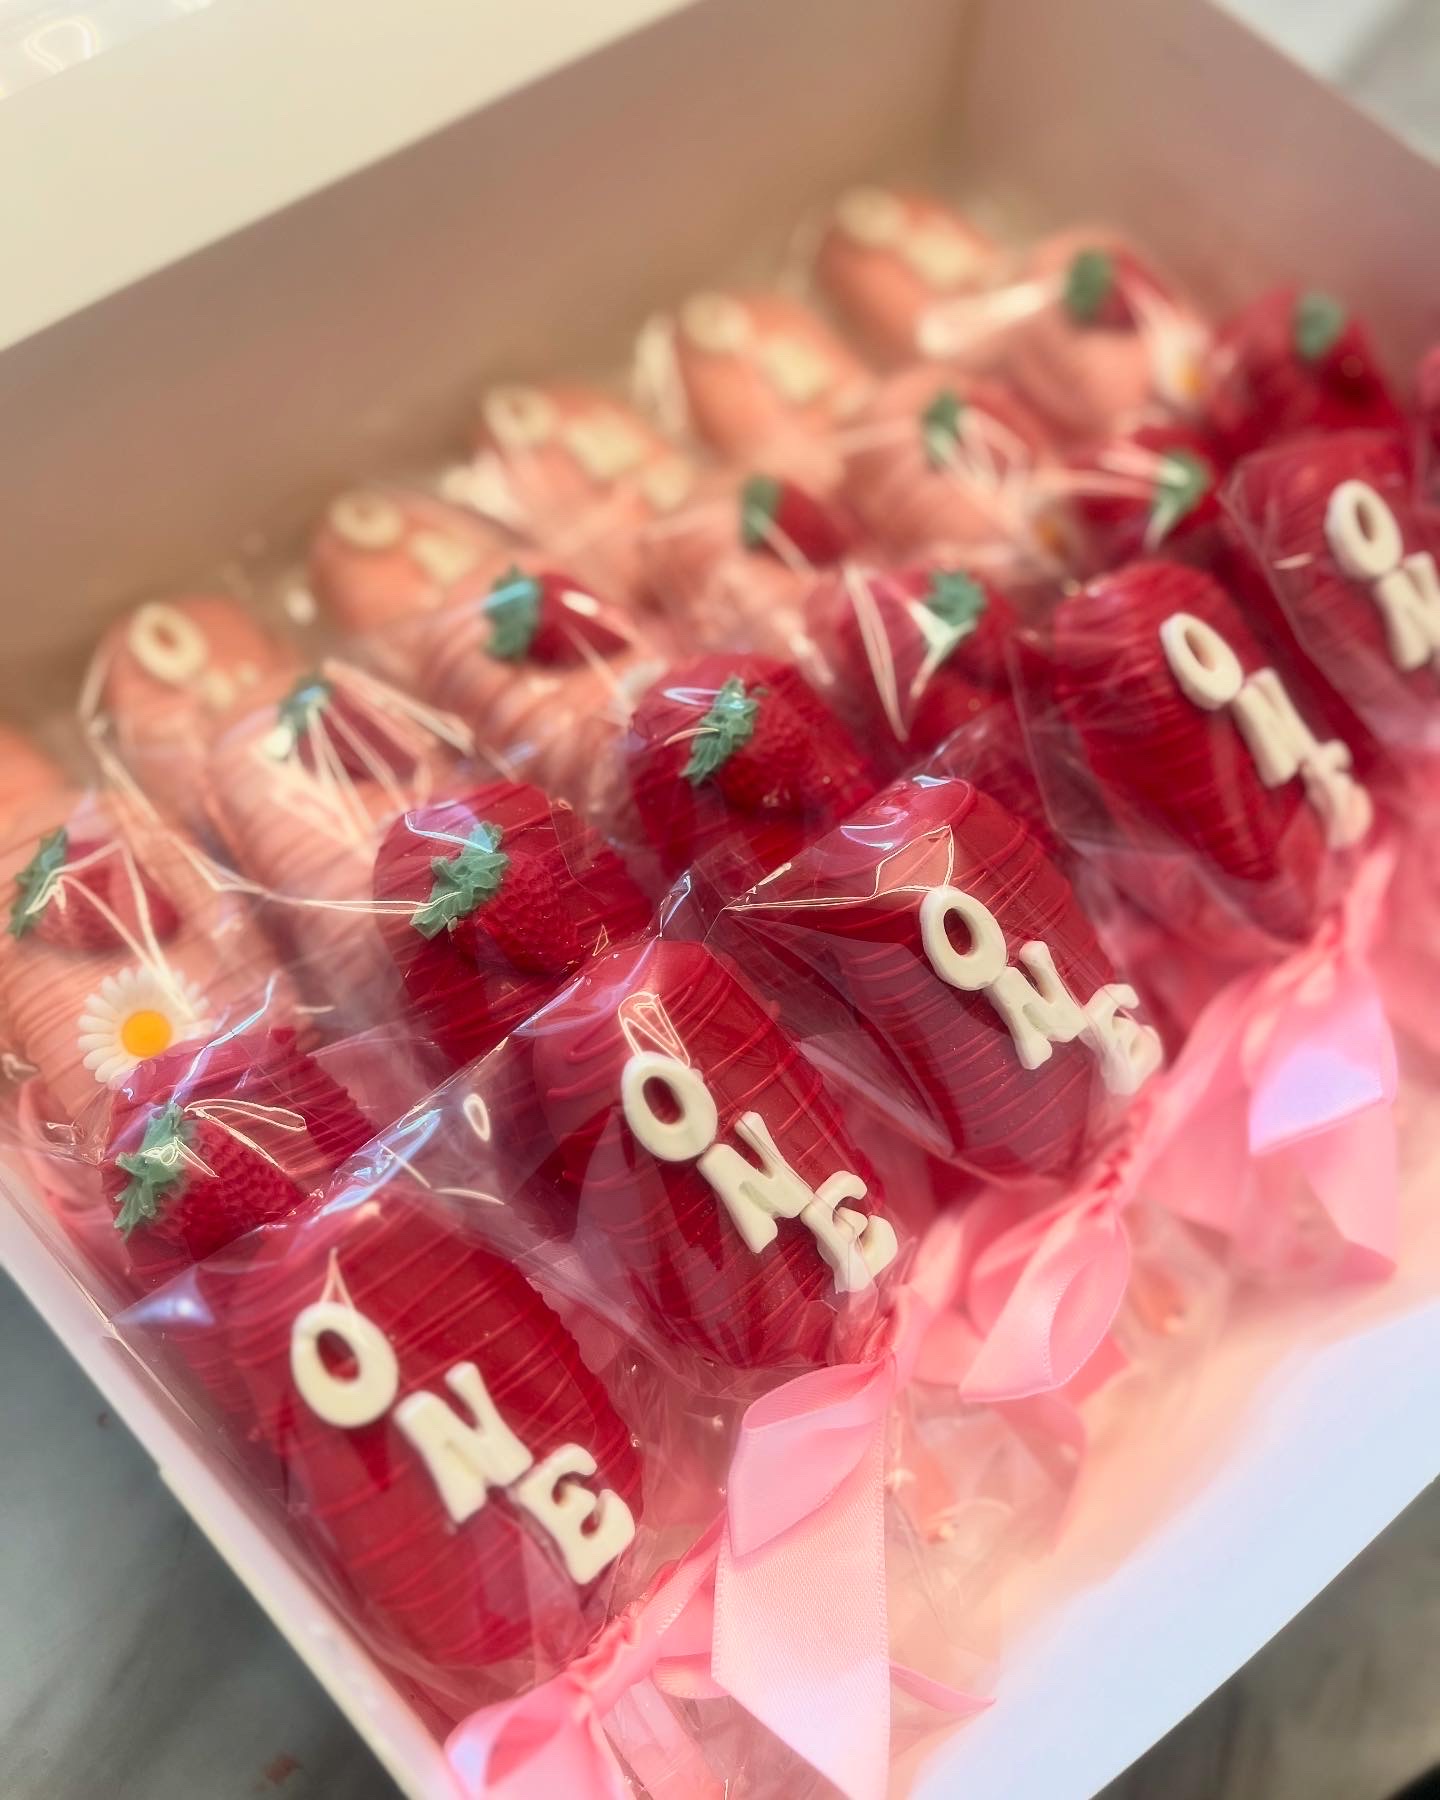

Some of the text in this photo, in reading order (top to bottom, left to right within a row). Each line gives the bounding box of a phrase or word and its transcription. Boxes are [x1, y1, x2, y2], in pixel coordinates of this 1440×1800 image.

[1325, 479, 1440, 672] ON
[1159, 612, 1372, 848] ONE
[920, 885, 1163, 1096] ONE
[621, 1051, 898, 1293] ONE
[291, 1302, 635, 1584] ONE
